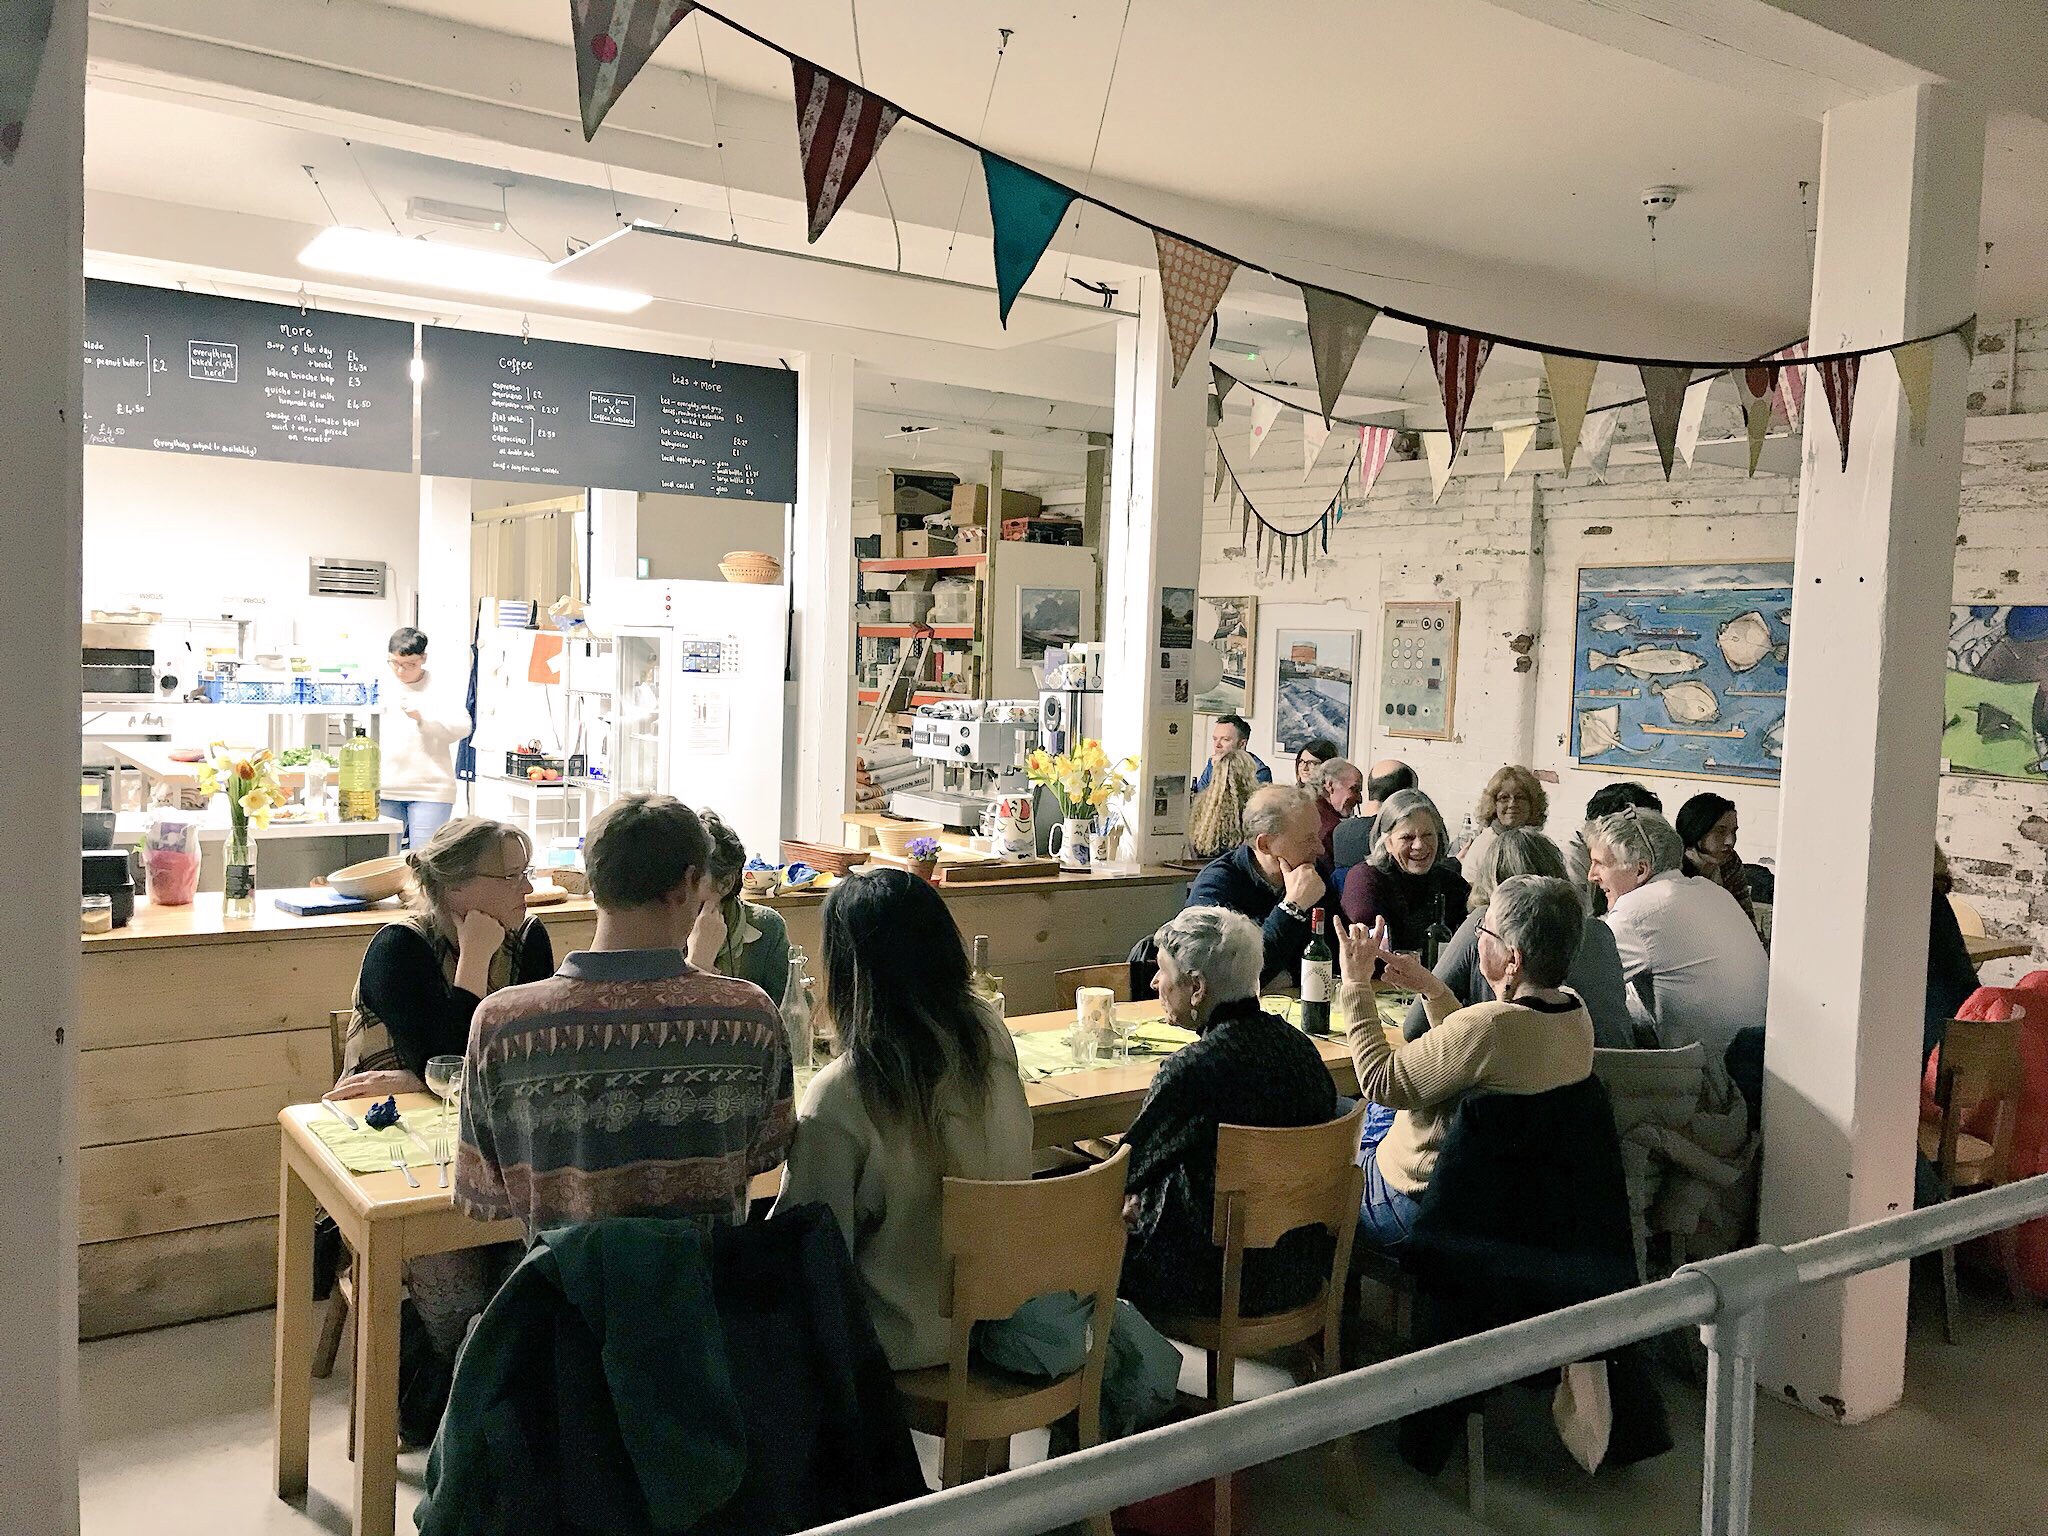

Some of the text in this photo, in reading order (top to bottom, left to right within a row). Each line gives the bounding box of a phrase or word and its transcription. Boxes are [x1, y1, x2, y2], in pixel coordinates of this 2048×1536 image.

[192, 348, 232, 361] everything
[290, 344, 299, 357] of
[303, 342, 317, 354] the
[318, 344, 334, 360] day
[347, 349, 360, 362] £4
[96, 357, 121, 369] peanut
[121, 356, 146, 367] butter
[152, 357, 168, 373] £2
[191, 357, 234, 372] baked right
[266, 366, 335, 386] bacon brioche bap
[348, 376, 362, 388] £3
[671, 372, 690, 387] teas
[264, 385, 292, 398] quiche
[302, 387, 317, 400] tart
[319, 391, 336, 402] with
[492, 382, 522, 392] espresso
[278, 395, 308, 407] homemade
[491, 390, 524, 402] americano
[532, 389, 543, 400] £2
[591, 395, 630, 407] coffee from
[660, 394, 671, 406] tea
[346, 398, 373, 410] £4.50
[265, 411, 291, 424] sausage
[314, 415, 340, 426] tomato
[491, 411, 507, 424] flat
[735, 413, 744, 425] £2
[271, 423, 289, 432] swirl
[297, 425, 317, 433] more
[324, 427, 348, 438] priced
[660, 426, 705, 441] hot chocolate
[287, 434, 333, 443] on counter
[661, 453, 675, 464] local
[676, 456, 692, 466] apple
[692, 457, 707, 468] juice
[661, 479, 675, 489] local
[886, 777, 928, 793] SHIPTON MILL
